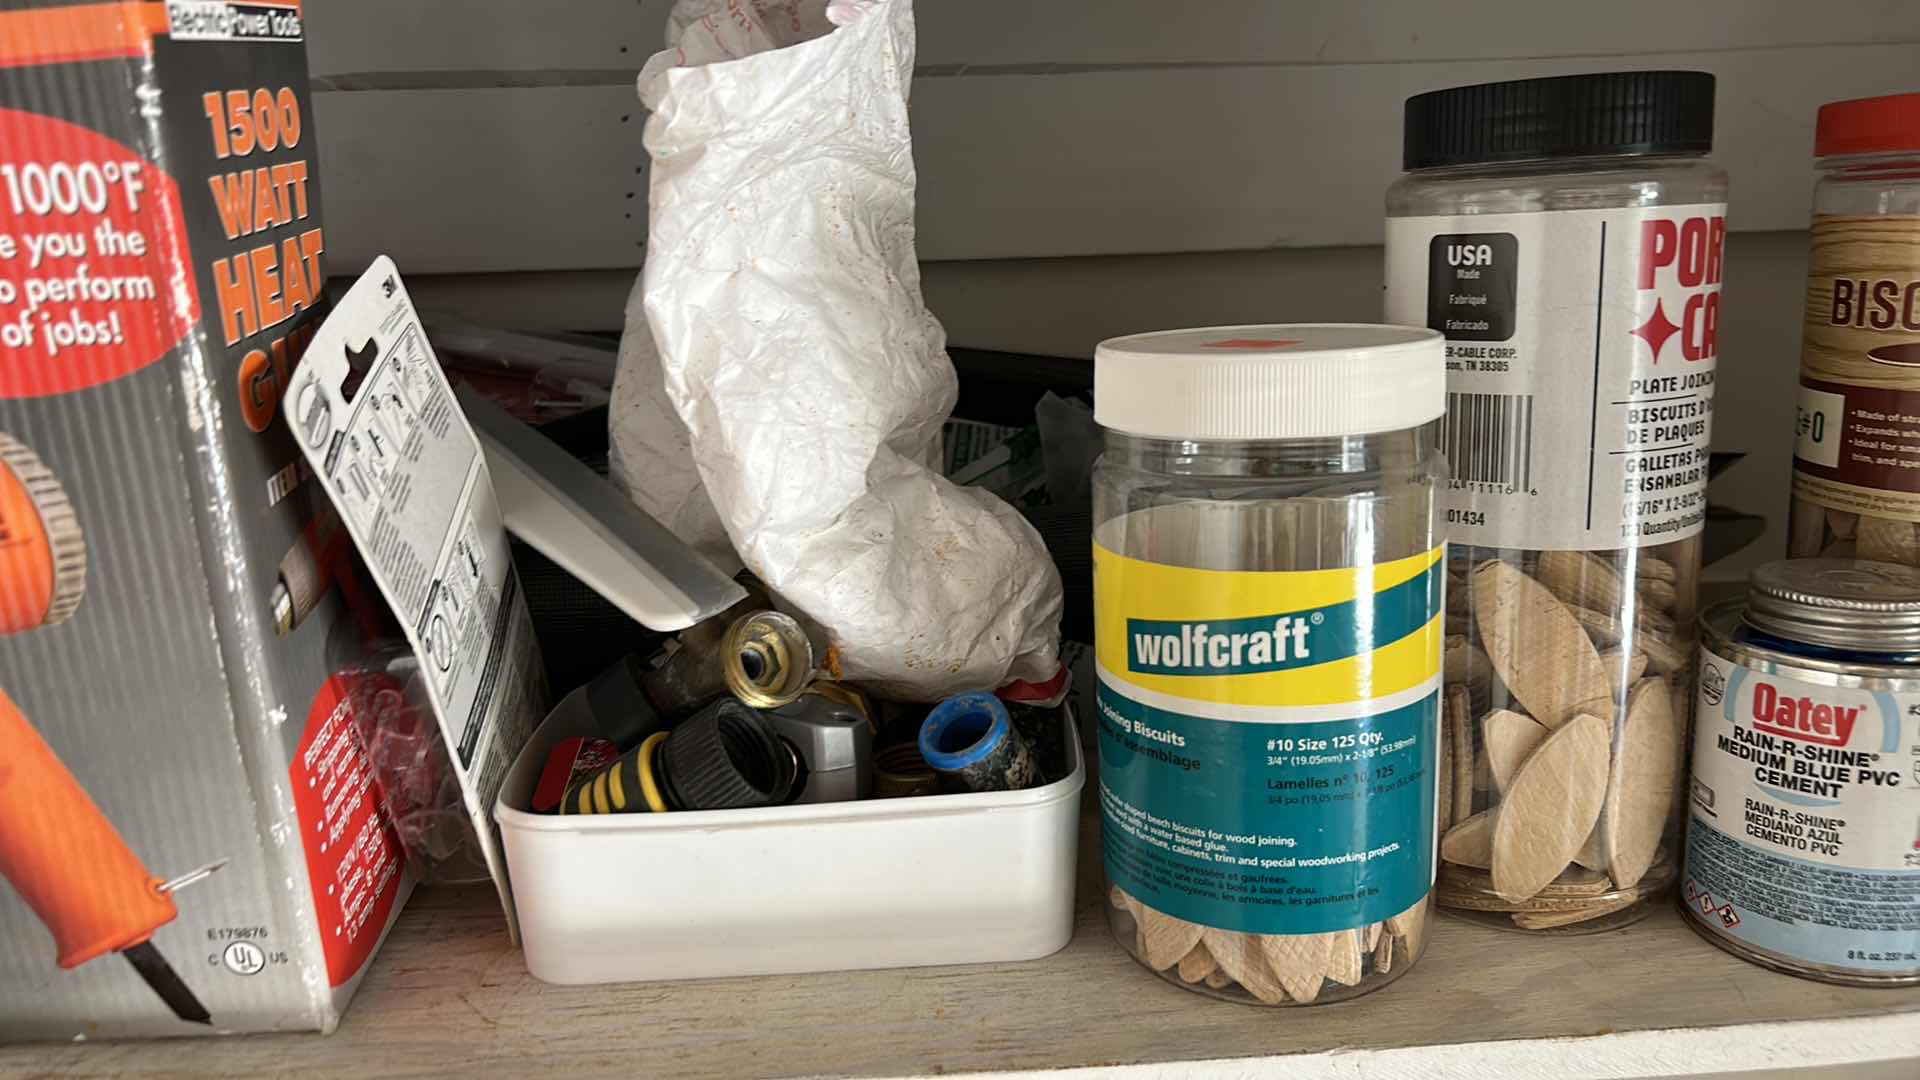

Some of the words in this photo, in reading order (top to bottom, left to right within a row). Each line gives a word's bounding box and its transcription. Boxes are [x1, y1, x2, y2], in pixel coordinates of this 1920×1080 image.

[203, 87, 301, 158] 1500
[0, 161, 145, 215] 1000°F
[209, 160, 309, 240] WATT
[23, 232, 86, 269] you
[94, 217, 146, 256] the
[1448, 245, 1492, 266] USA
[24, 262, 156, 312] perform
[212, 228, 325, 347] HEAT
[2, 308, 35, 347] of
[41, 307, 125, 356] jobs!
[1446, 319, 1489, 331] Fabricado
[1466, 360, 1477, 371] TN
[1479, 361, 1509, 372] 38305
[1488, 347, 1518, 360] CORP.
[1630, 376, 1677, 395] PLATE
[1628, 402, 1697, 424] BISCUITS
[1627, 428, 1648, 444] DE
[1654, 420, 1705, 443] PLAQUES
[1625, 451, 1692, 473] GALLETAS
[1448, 508, 1485, 526] 01434
[1752, 682, 1859, 747] Oatey
[1134, 719, 1186, 747] Biscuits
[1267, 739, 1293, 751] #10
[1297, 738, 1327, 751] Size
[1332, 735, 1355, 748] 125
[1359, 731, 1384, 746] Qty.
[1290, 753, 1344, 767] (19.05mm)
[1718, 733, 1787, 772] MEDIUM
[1793, 760, 1850, 783] BLUE
[1858, 769, 1901, 787] PVC
[1267, 775, 1329, 790] Lamelles
[1376, 764, 1395, 779] 125
[1755, 766, 1843, 798] CEMENT
[1150, 826, 1175, 841] water
[1175, 832, 1202, 848] based
[1204, 839, 1230, 853] glue.
[1172, 820, 1207, 839] biscuits
[1208, 829, 1223, 841] for
[1225, 833, 1256, 845] wood
[1258, 834, 1298, 848] joining.
[1745, 809, 1804, 837] MEDIANO
[1807, 828, 1844, 845] AZUL
[1745, 823, 1807, 850] CEMENTO
[1810, 841, 1840, 857] PVC
[1171, 842, 1214, 862] cabinets,
[1214, 852, 1237, 864] trim
[1238, 856, 1258, 867] and
[1260, 857, 1296, 869] special
[1298, 850, 1367, 868] woodworking
[1367, 841, 1401, 861] projects.
